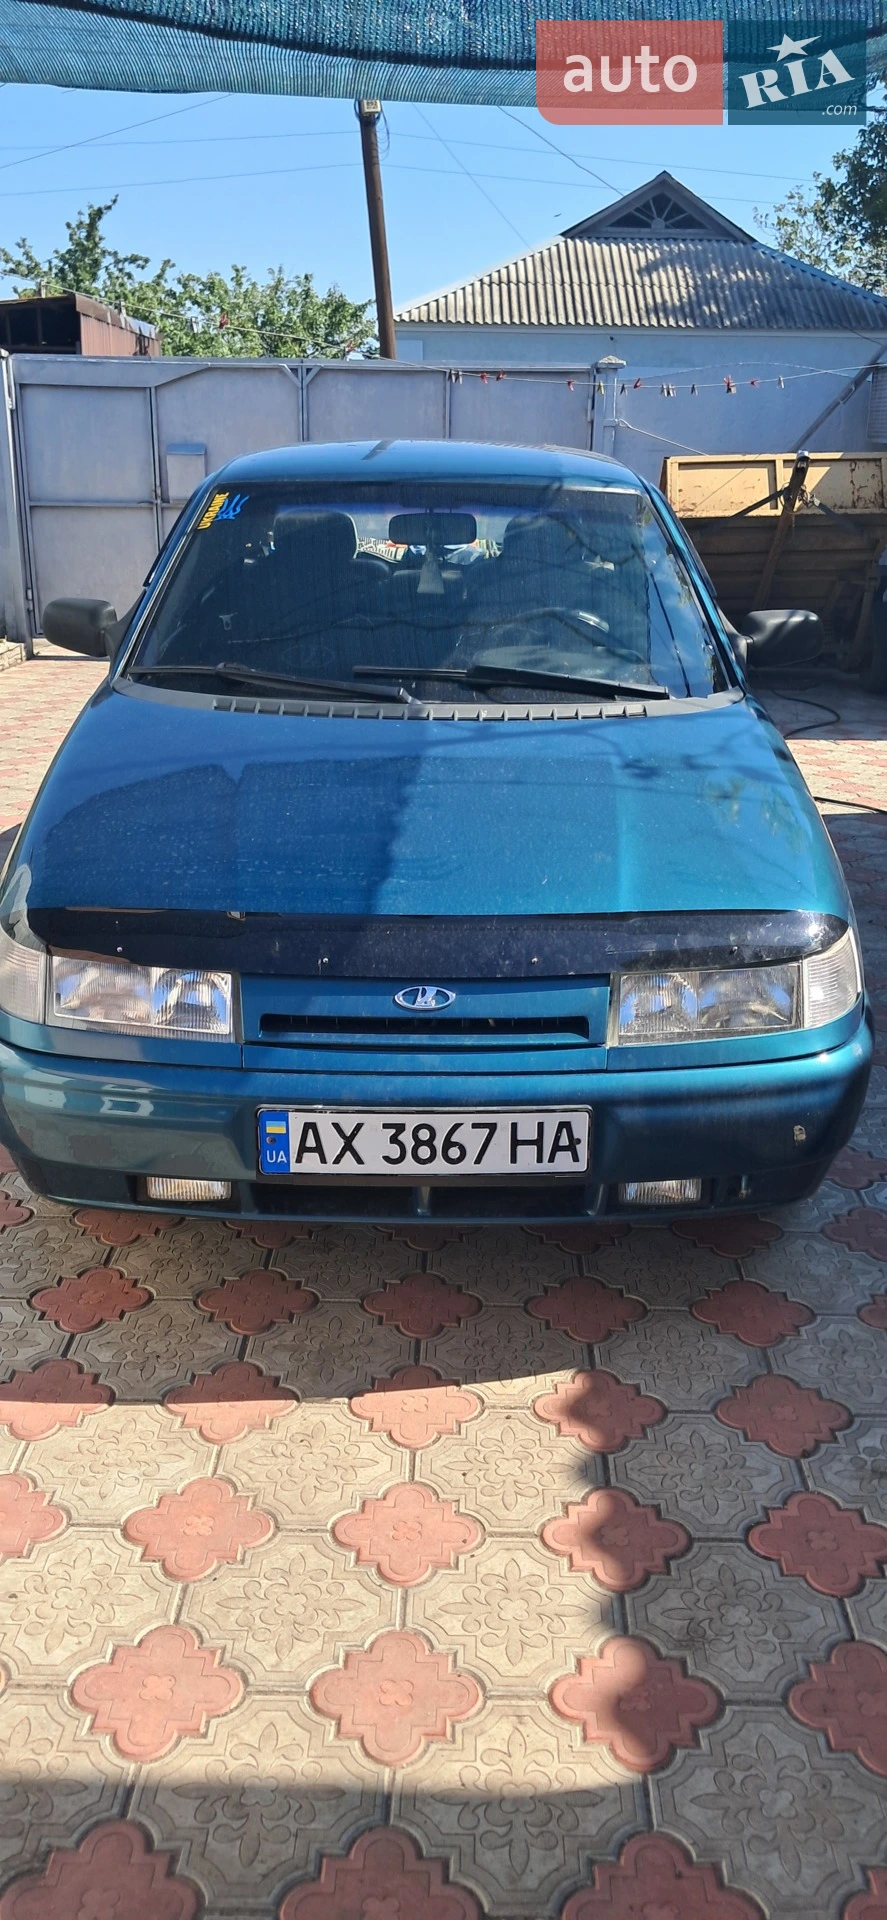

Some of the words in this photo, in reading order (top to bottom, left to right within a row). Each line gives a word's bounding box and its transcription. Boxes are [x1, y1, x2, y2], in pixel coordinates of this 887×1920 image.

[197, 492, 229, 529] UKRAINE
[266, 1149, 288, 1164] UA
[294, 1121, 365, 1165] AX
[381, 1122, 498, 1166] 3867
[508, 1120, 581, 1165] HA
